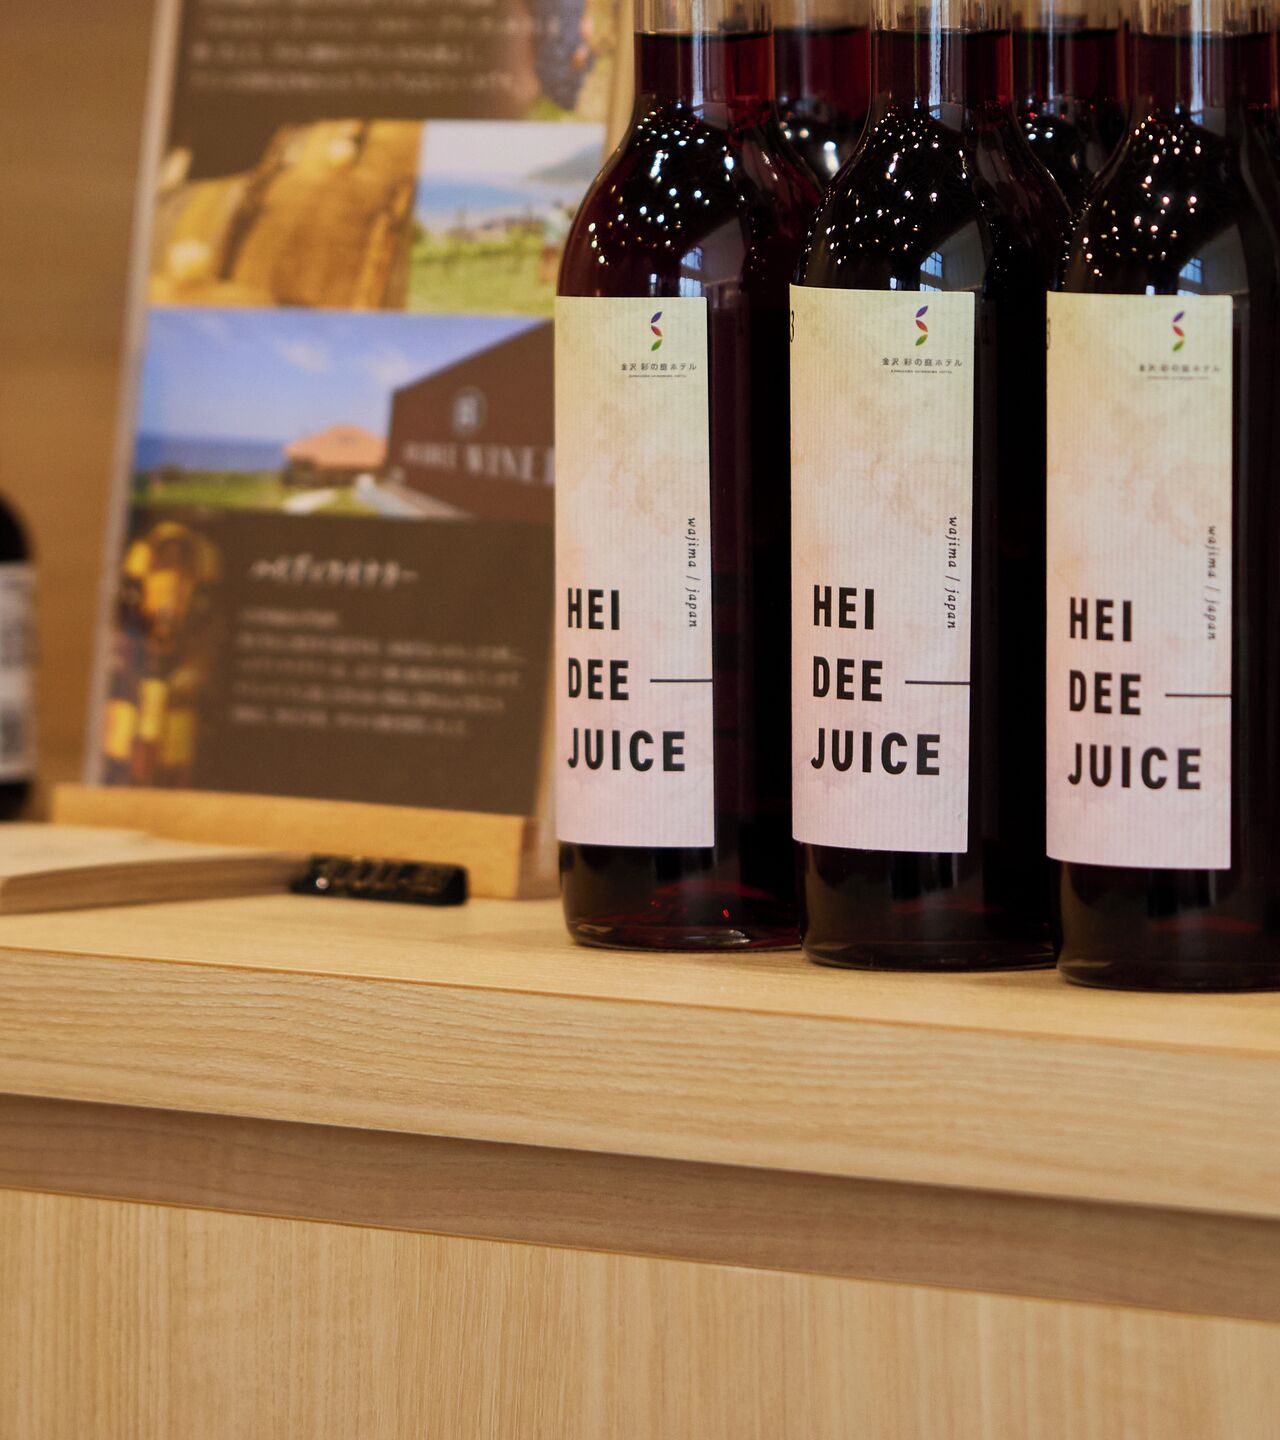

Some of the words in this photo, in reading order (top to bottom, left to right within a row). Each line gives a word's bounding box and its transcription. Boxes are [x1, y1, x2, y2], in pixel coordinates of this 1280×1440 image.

[567, 587, 620, 631] HEI
[813, 585, 875, 631] HEI
[1069, 597, 1132, 642] HEI
[568, 657, 629, 701] DEE
[812, 656, 883, 702] DEE
[1069, 669, 1142, 716] DEE
[567, 728, 685, 772] JUICE
[810, 727, 941, 776] JUICE
[1067, 743, 1201, 790] JUICE
